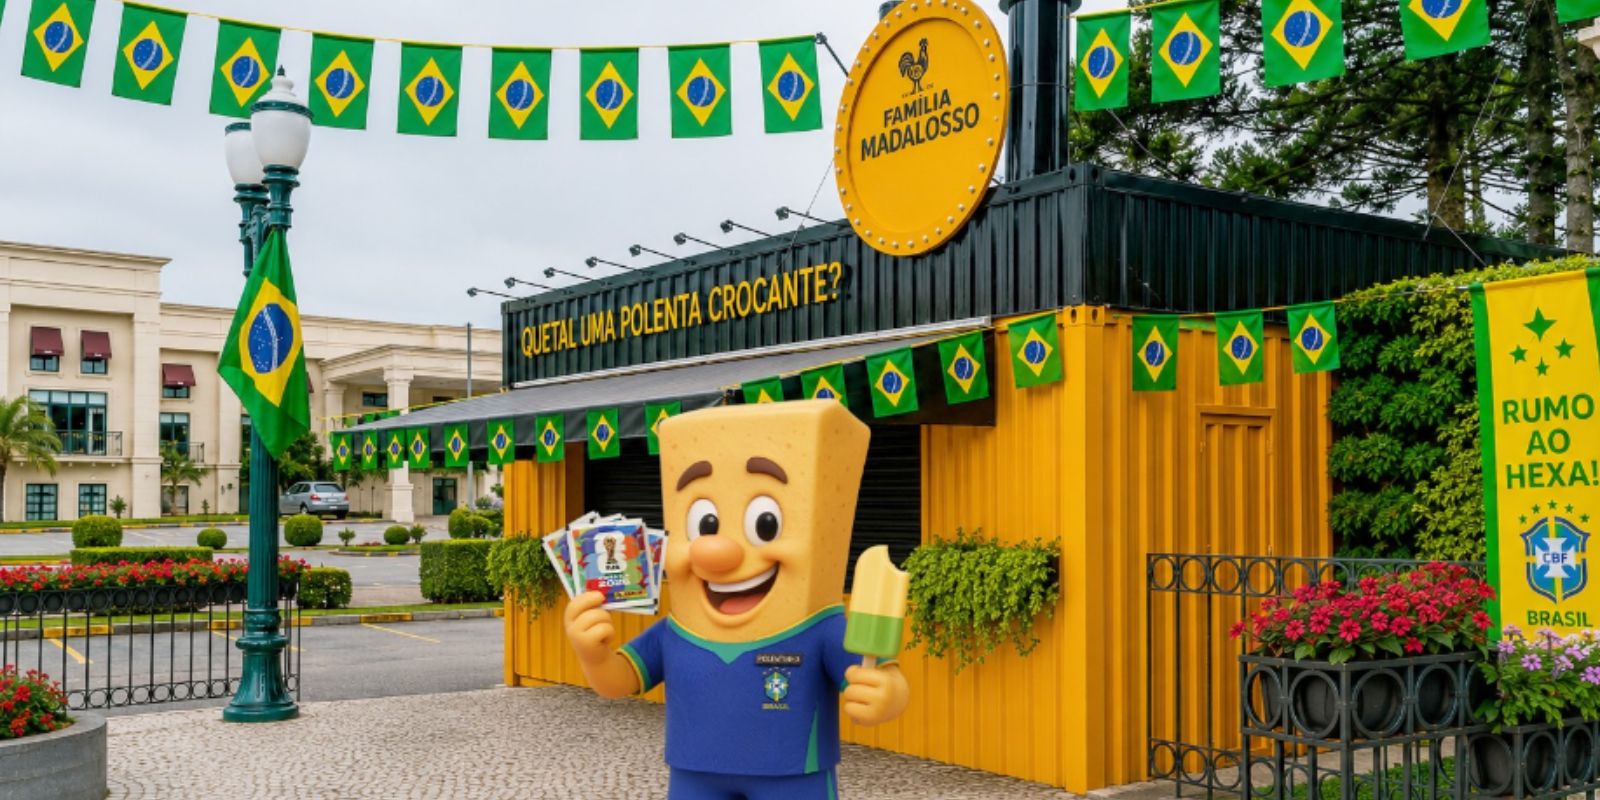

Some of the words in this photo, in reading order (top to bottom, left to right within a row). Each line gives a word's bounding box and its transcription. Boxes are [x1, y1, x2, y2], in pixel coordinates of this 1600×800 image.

[861, 102, 980, 161] MADALOSSO
[521, 320, 577, 358] QUETAL
[580, 309, 616, 346] UMA
[620, 291, 702, 338] POLENTA
[708, 261, 842, 323] CROCANTE?
[1502, 393, 1595, 425] RUMO
[1526, 427, 1571, 456] AO
[1506, 460, 1599, 490] HEXA!
[1542, 552, 1568, 564] CBF
[1527, 610, 1593, 627] BRASIL
